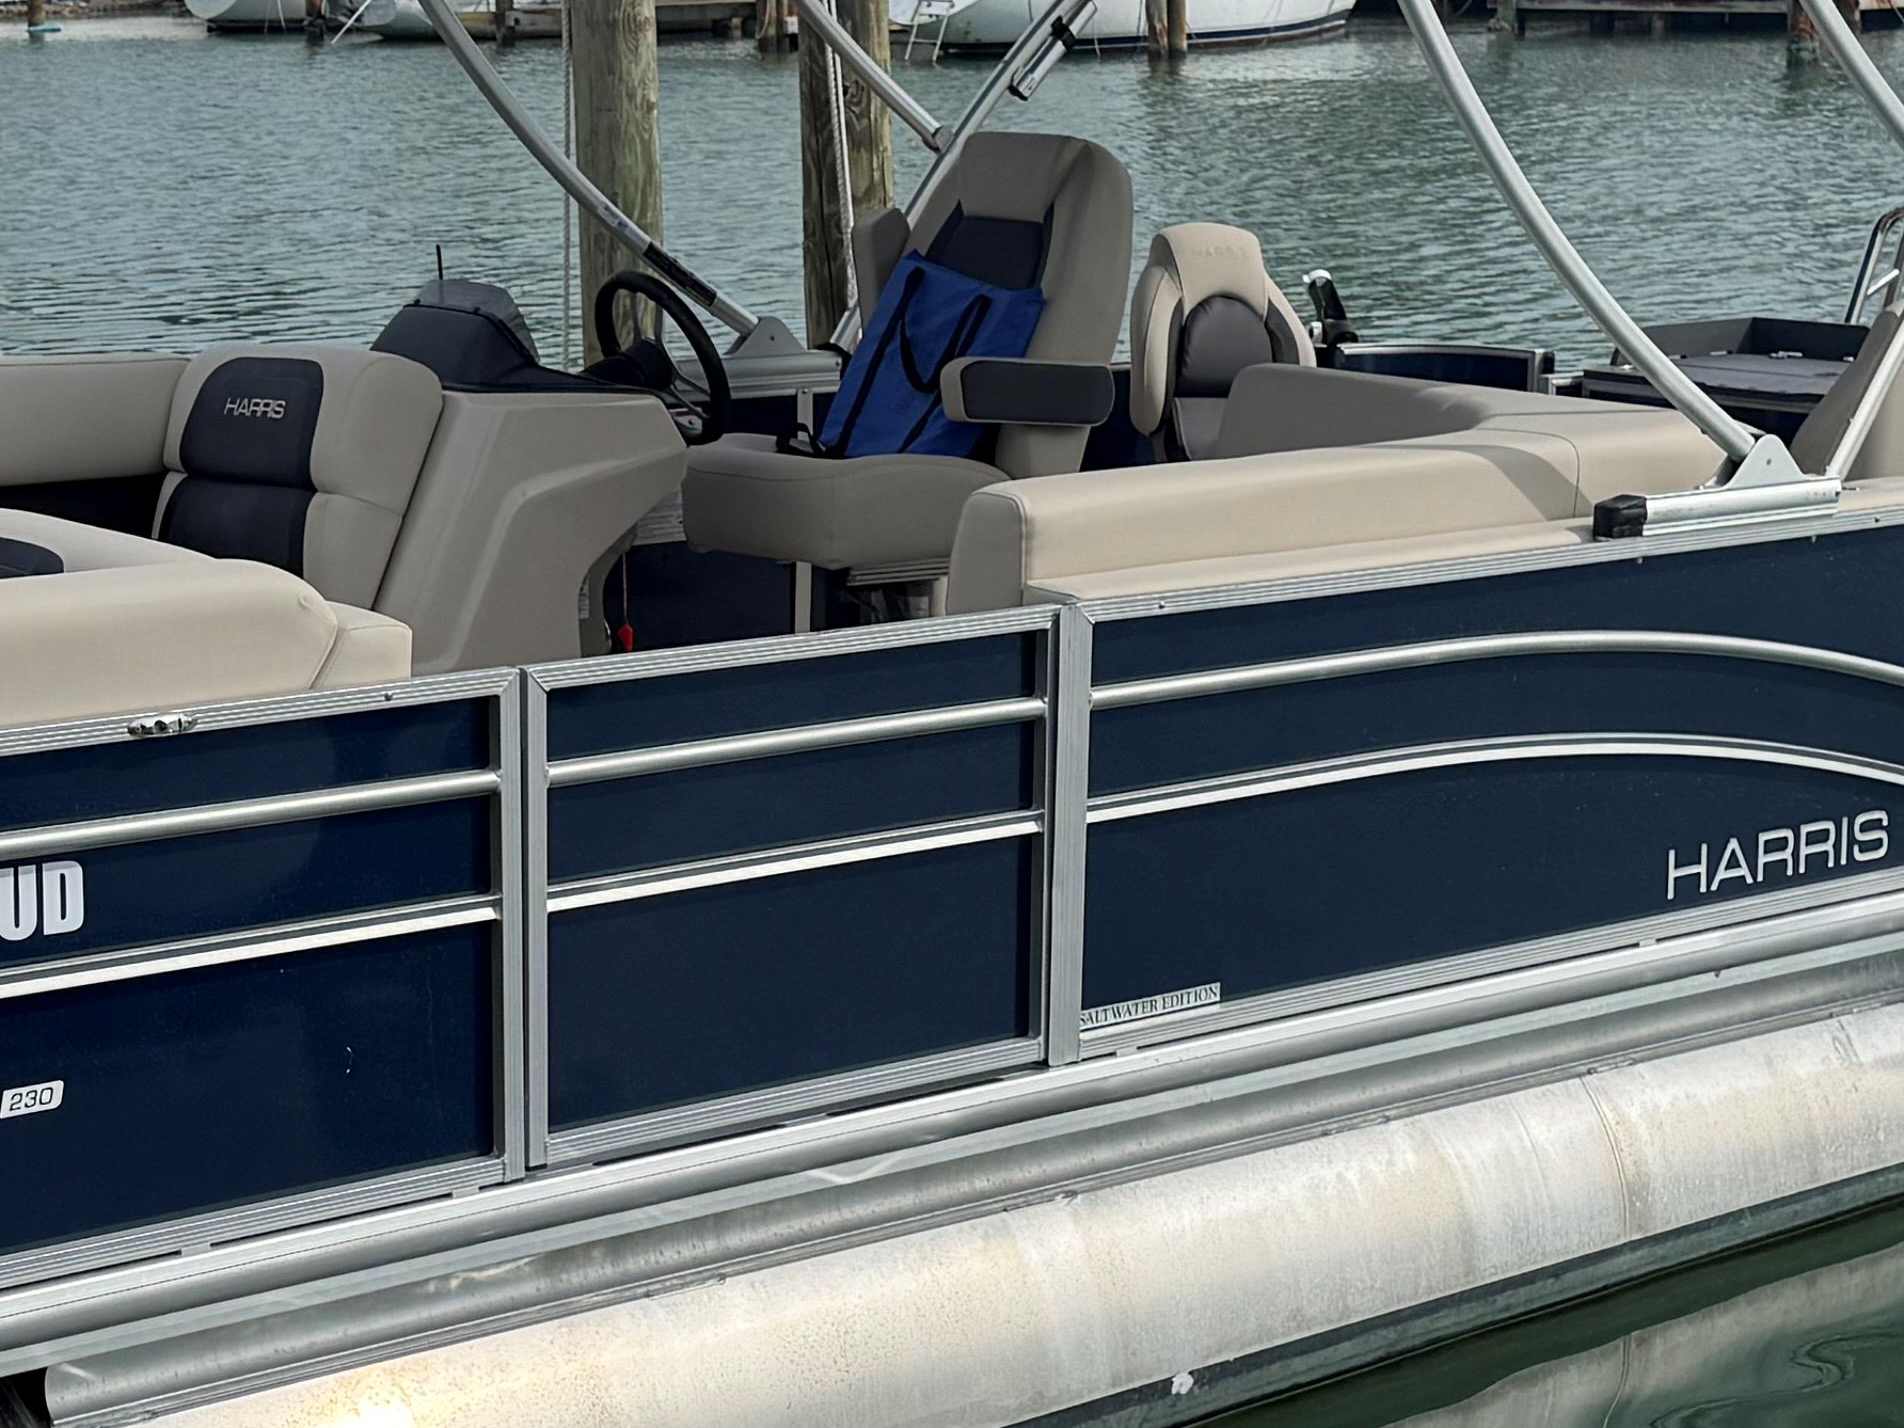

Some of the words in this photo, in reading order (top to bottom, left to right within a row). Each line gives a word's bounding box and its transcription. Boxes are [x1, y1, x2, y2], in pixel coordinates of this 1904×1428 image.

[223, 396, 287, 419] HARRIS
[1667, 809, 1889, 900] HARRIS
[1162, 985, 1219, 1010] EDITION
[9, 1085, 55, 1113] 230
